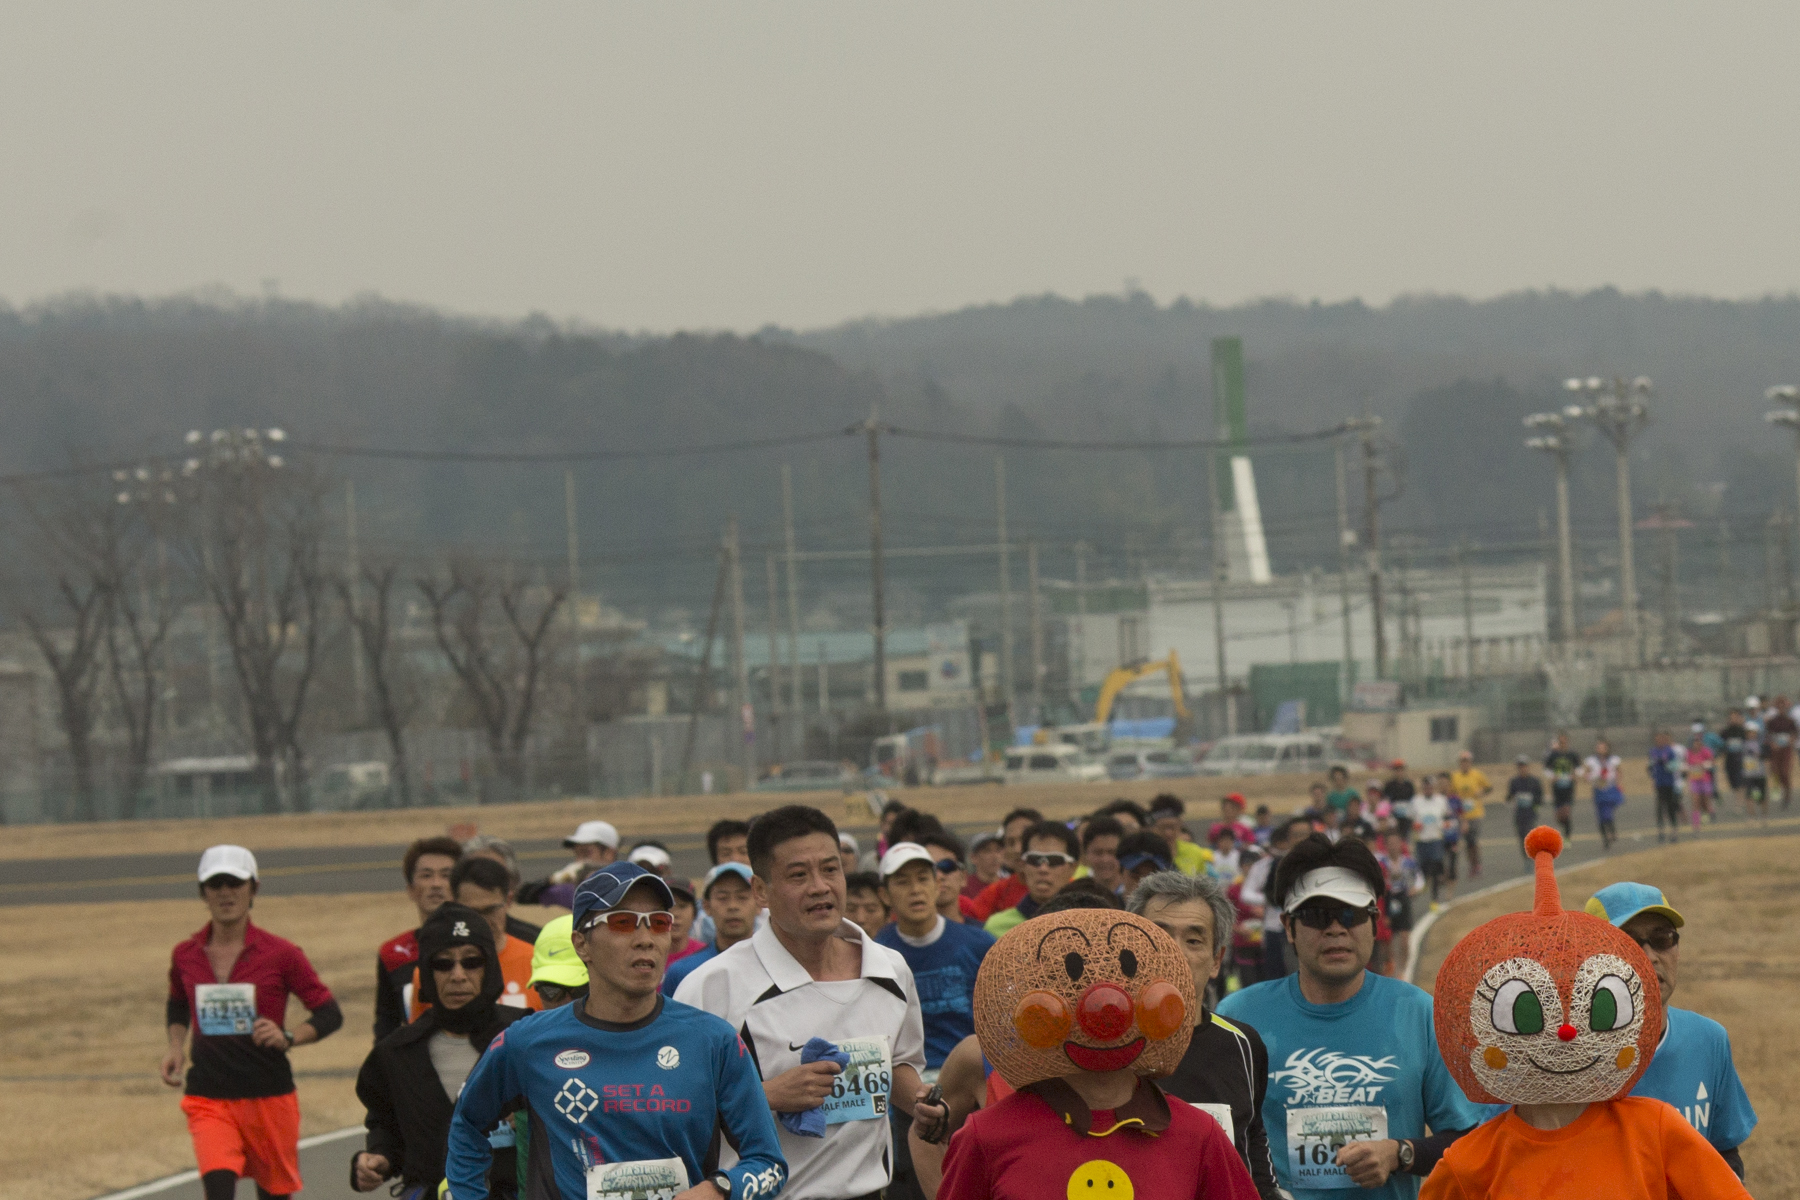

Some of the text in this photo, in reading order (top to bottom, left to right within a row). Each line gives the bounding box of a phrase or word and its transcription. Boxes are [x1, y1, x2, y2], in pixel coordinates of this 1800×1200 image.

[603, 1084, 665, 1097] SET A
[831, 1071, 890, 1099] 6468
[603, 1099, 691, 1113] RECORD
[842, 1099, 866, 1109] MALE
[587, 1136, 605, 1165] POWE
[1300, 1168, 1321, 1177] HALF
